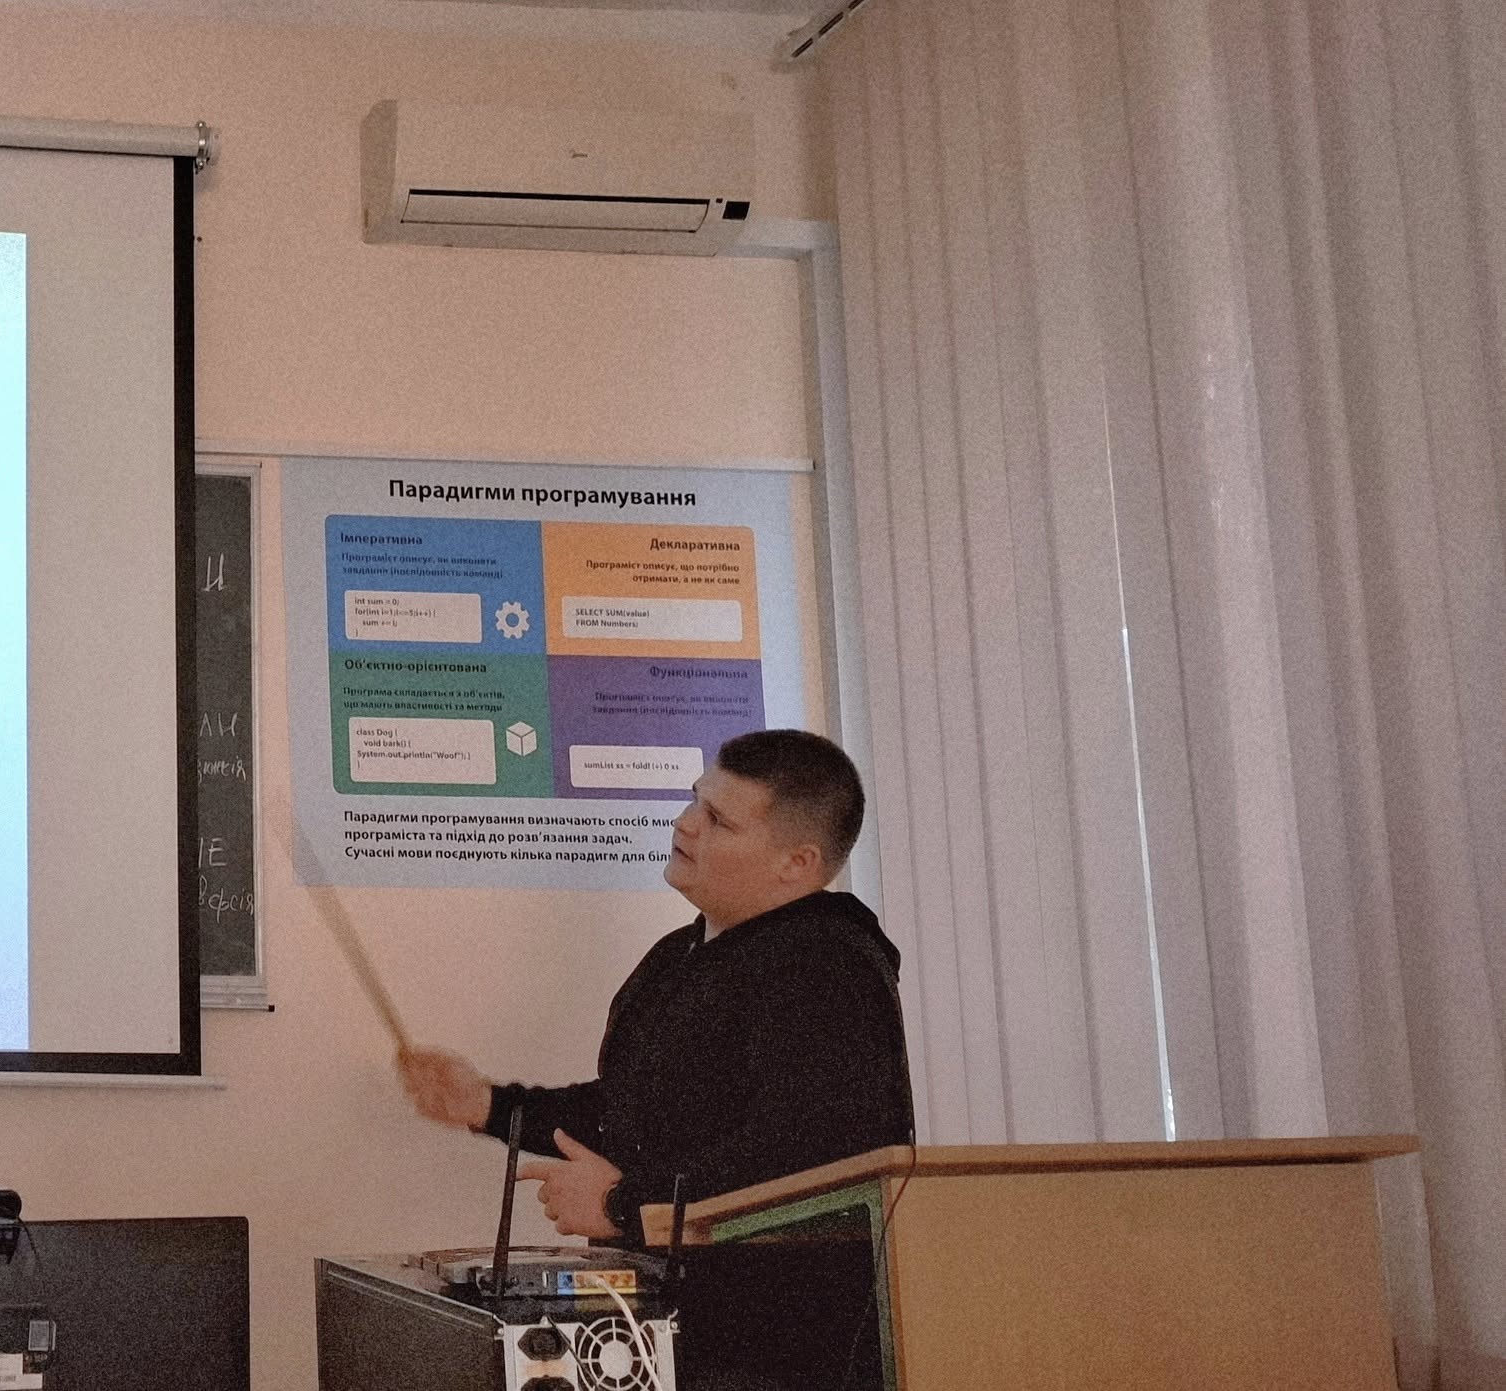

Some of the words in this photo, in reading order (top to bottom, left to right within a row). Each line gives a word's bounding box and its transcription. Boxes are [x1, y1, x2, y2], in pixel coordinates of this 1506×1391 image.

[389, 479, 515, 503] Парадигми
[521, 487, 696, 509] програмування
[340, 532, 423, 547] Імперативна
[650, 538, 741, 552] Декларативна
[586, 559, 641, 571] Програміст
[680, 563, 695, 573] що
[696, 563, 740, 574] потрібно
[717, 577, 740, 585] саме
[575, 608, 604, 617] SELECT
[605, 608, 650, 618] SUM(value)
[575, 619, 599, 627] FROM
[356, 728, 375, 736] class
[376, 729, 393, 738] Dog
[363, 740, 381, 748] void
[584, 761, 614, 770] sumList
[344, 810, 418, 825] Парадигми
[421, 813, 525, 826] програмування
[528, 815, 606, 827] визначають
[608, 815, 649, 827] спосіб
[344, 828, 426, 843] програміста
[429, 831, 443, 841] та
[445, 829, 486, 844] підхід
[488, 832, 505, 844] до
[591, 833, 633, 846] задач.
[345, 846, 395, 860] Сучасні
[397, 849, 432, 859] мови
[435, 849, 508, 862] поєднують
[510, 848, 552, 860] кілька
[555, 851, 619, 863] парадигм
[621, 852, 645, 863] для
